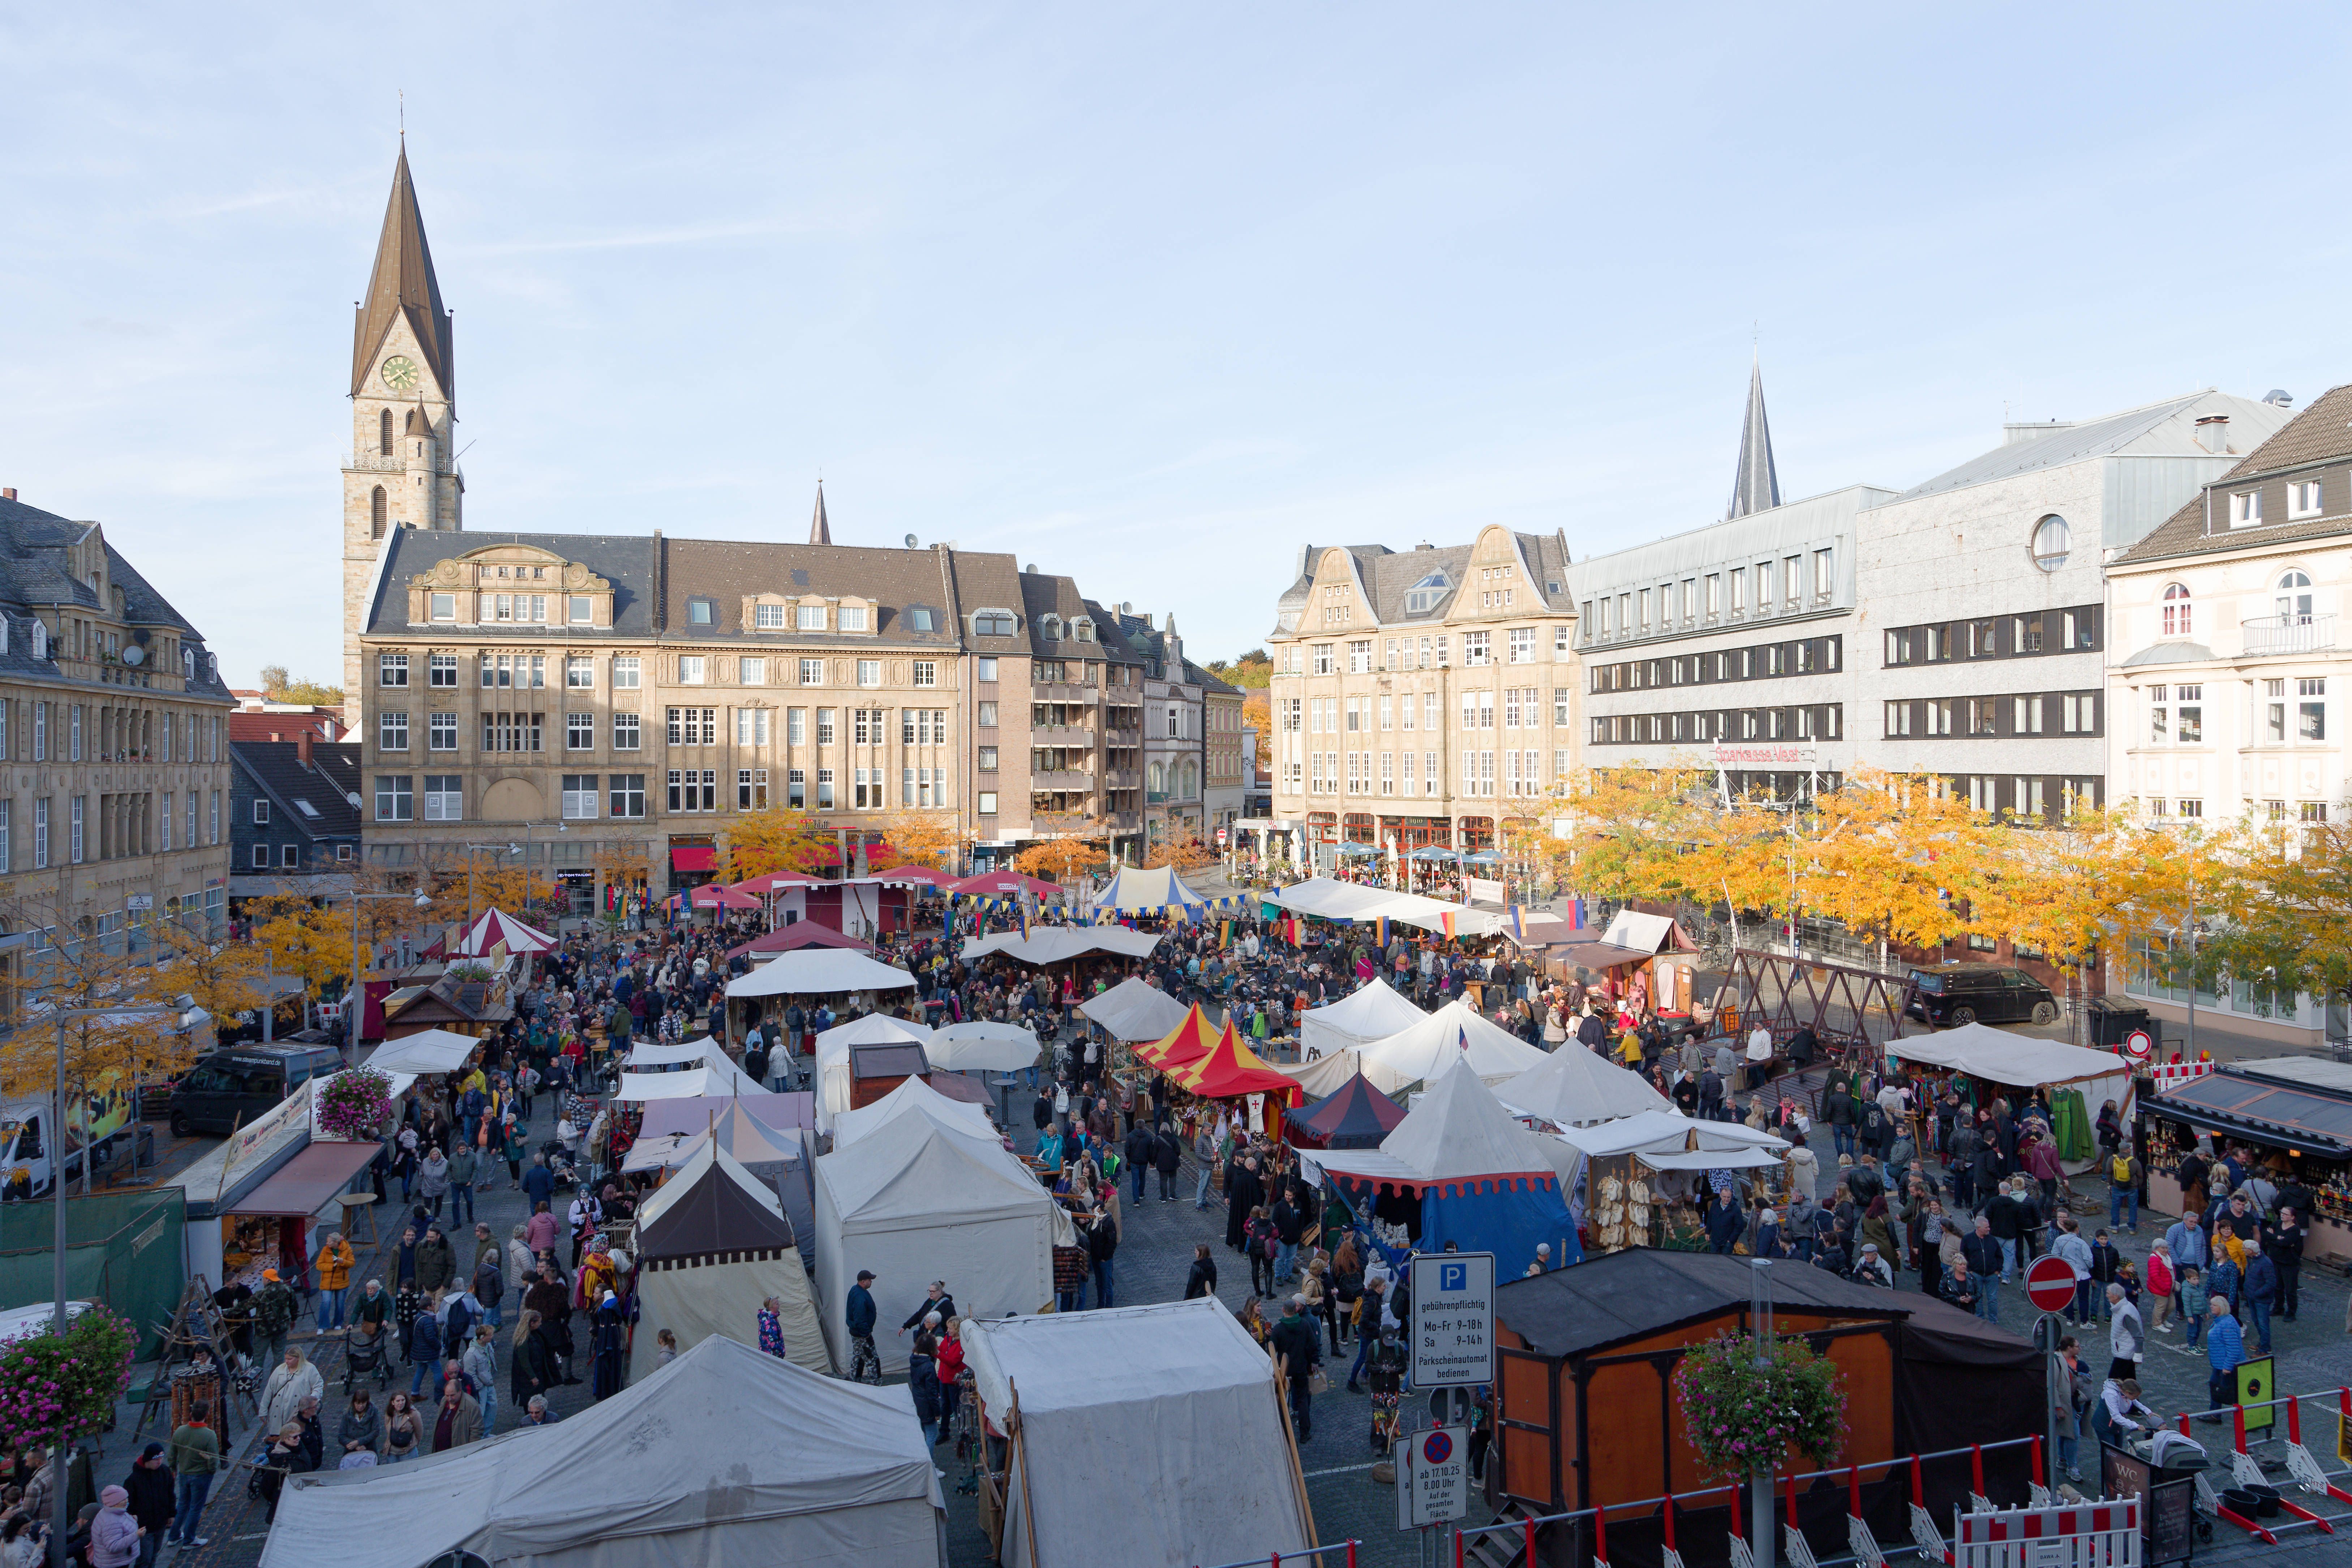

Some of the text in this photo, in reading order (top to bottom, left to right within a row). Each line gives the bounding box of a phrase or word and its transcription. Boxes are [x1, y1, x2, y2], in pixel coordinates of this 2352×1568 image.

[1715, 746, 1799, 765] Sparkasse Vest
[232, 1056, 281, 1066] www.steampunkband.de
[1447, 1267, 1460, 1288] P
[1422, 1299, 1485, 1313] gebührenpflichtig
[1424, 1320, 1451, 1332] Mo-Fr
[1424, 1337, 1435, 1348] Sa
[1419, 1354, 1487, 1366] Parkscheinautomat
[1437, 1368, 1469, 1378] bedienen
[1420, 1465, 1460, 1479] ab 17.10.25
[2115, 1462, 2138, 1482] WC
[1424, 1478, 1455, 1490] 8.00 Uhr
[2310, 1479, 2324, 1490] HTS
[1429, 1491, 1439, 1500] Auf
[1425, 1500, 1454, 1511] gesamten
[1430, 1510, 1449, 1518] Fläche
